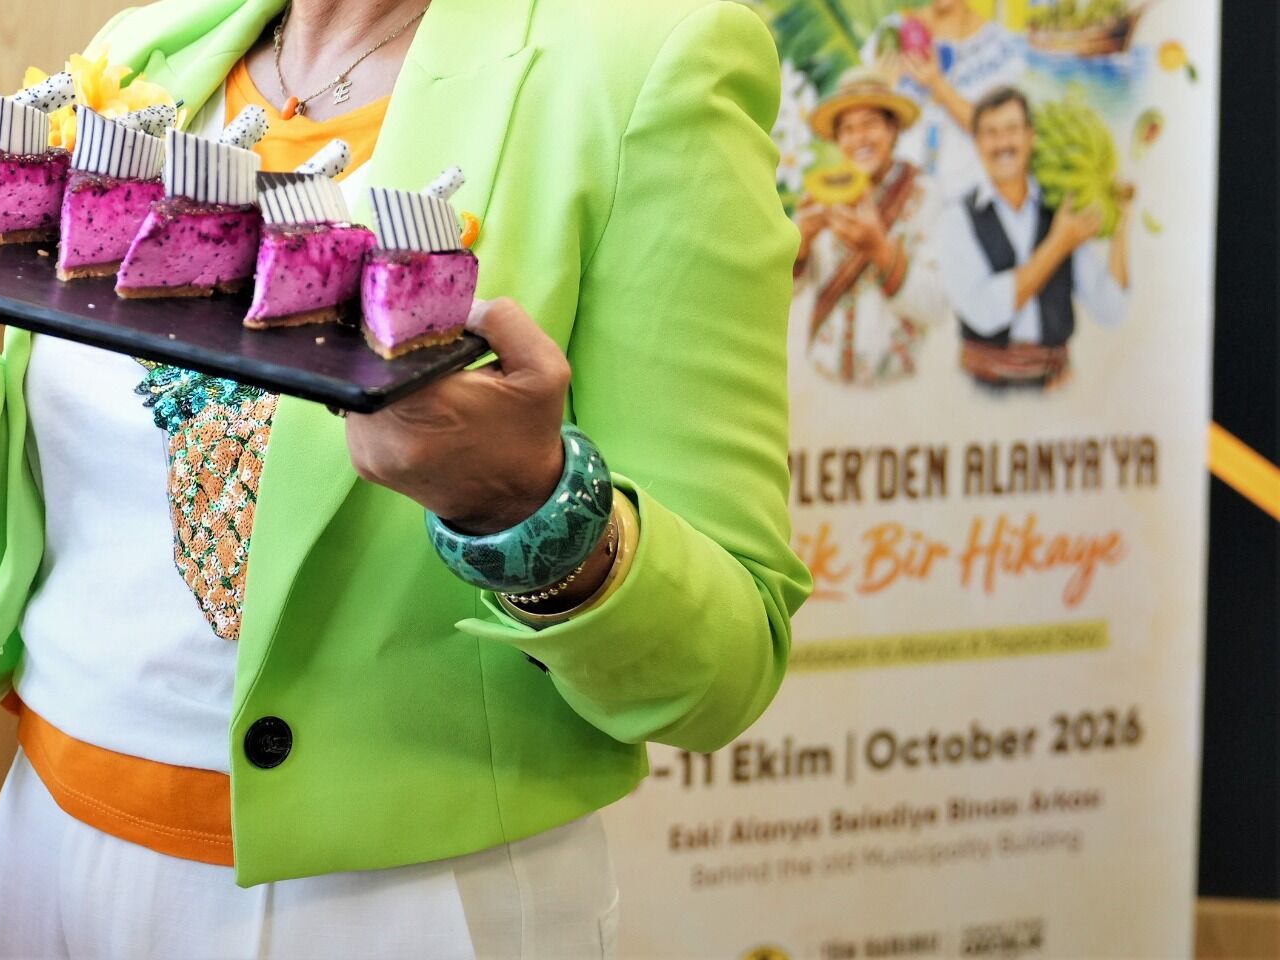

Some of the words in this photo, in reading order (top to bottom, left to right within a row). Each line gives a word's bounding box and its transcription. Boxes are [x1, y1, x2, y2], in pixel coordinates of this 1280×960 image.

[788, 444, 949, 506] LER'DEN
[963, 433, 1159, 500] ALANYA'YA
[856, 521, 951, 596] Bir
[958, 513, 1126, 608] Hikaye
[731, 734, 834, 786] Ekim
[864, 720, 1038, 773] October
[1049, 704, 1145, 753] 2026
[729, 814, 822, 851] Alanya
